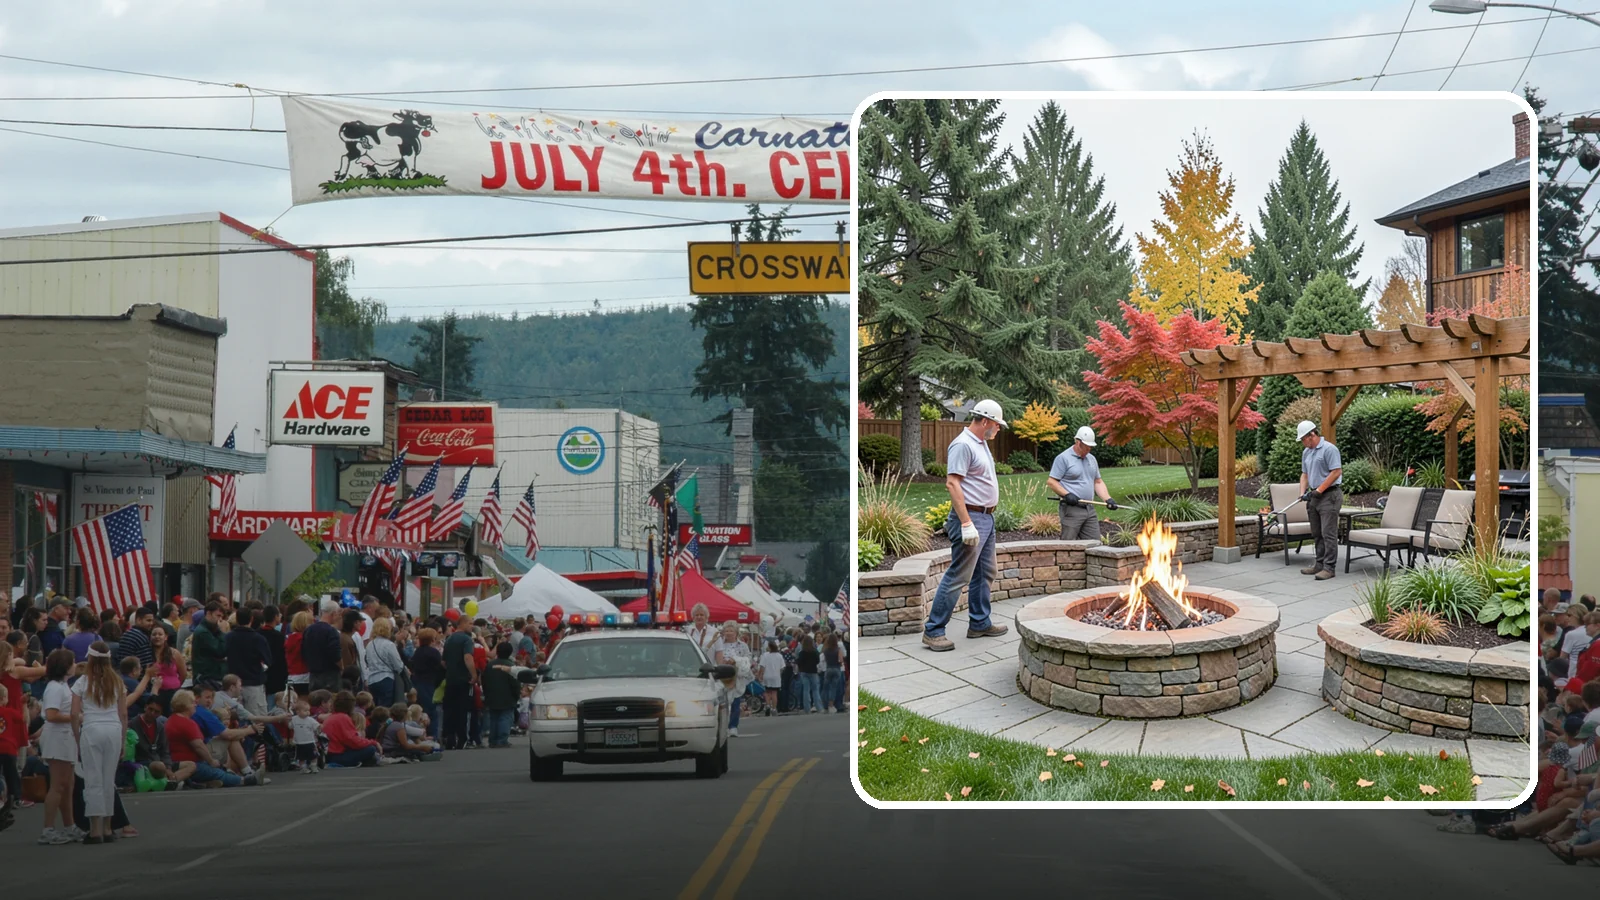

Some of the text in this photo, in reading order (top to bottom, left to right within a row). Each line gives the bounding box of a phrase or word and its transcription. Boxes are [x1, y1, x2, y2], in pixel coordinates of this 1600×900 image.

[481, 141, 604, 192] JULY
[633, 150, 747, 198] 4th.
[697, 254, 850, 280] CROSSWA
[283, 380, 373, 419] ACE
[406, 409, 452, 422] CEDAR
[284, 421, 370, 436] Hardware
[416, 428, 477, 446] Coca-Cola
[95, 485, 124, 495] Vincent
[126, 486, 136, 495] de
[137, 487, 155, 495] Paul
[699, 535, 730, 543] GLASS
